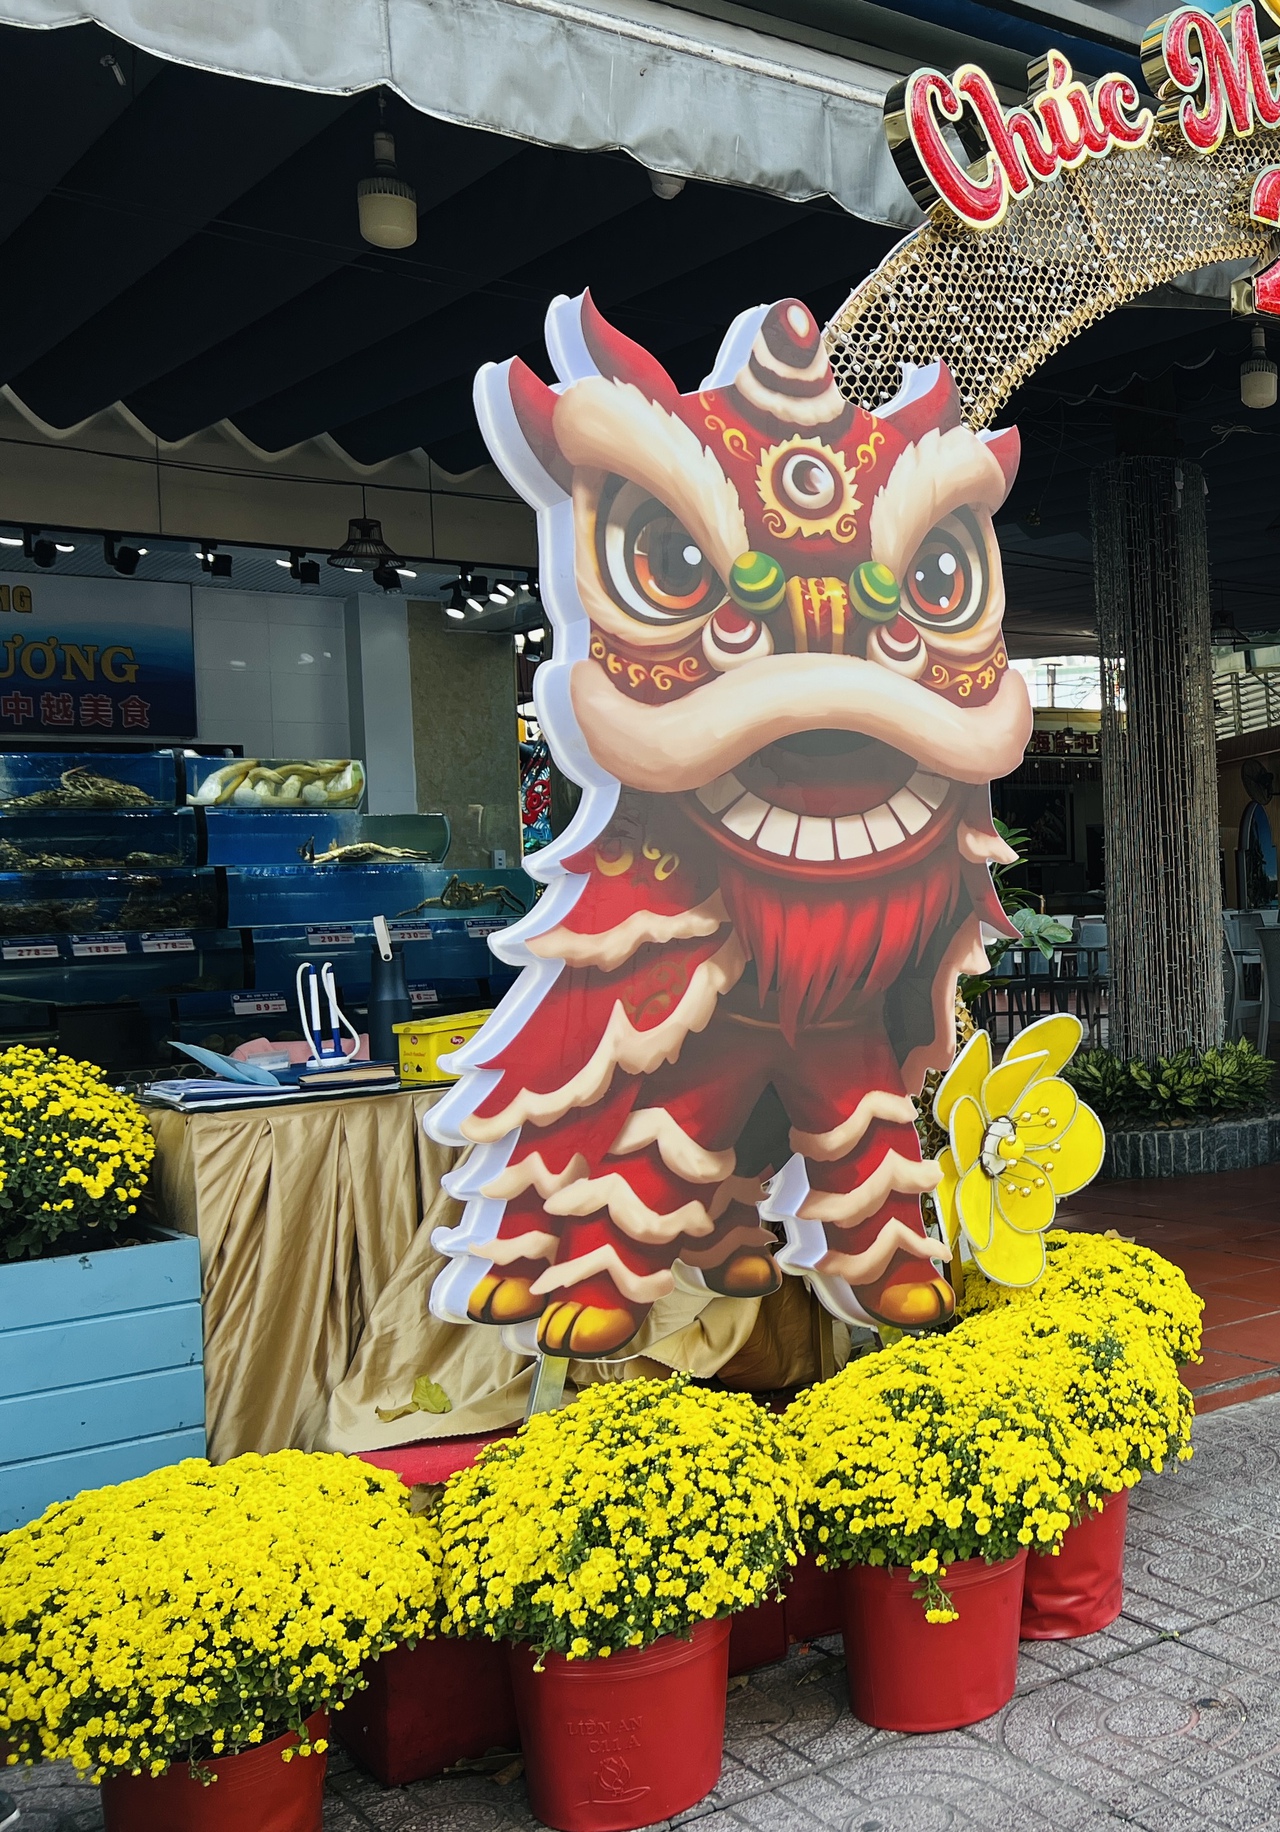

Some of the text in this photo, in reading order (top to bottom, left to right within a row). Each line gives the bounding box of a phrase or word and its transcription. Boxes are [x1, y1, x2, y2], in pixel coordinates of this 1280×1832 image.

[905, 48, 1154, 231] Chúc
[1, 690, 151, 730] 中越美食
[256, 1003, 270, 1011] 89
